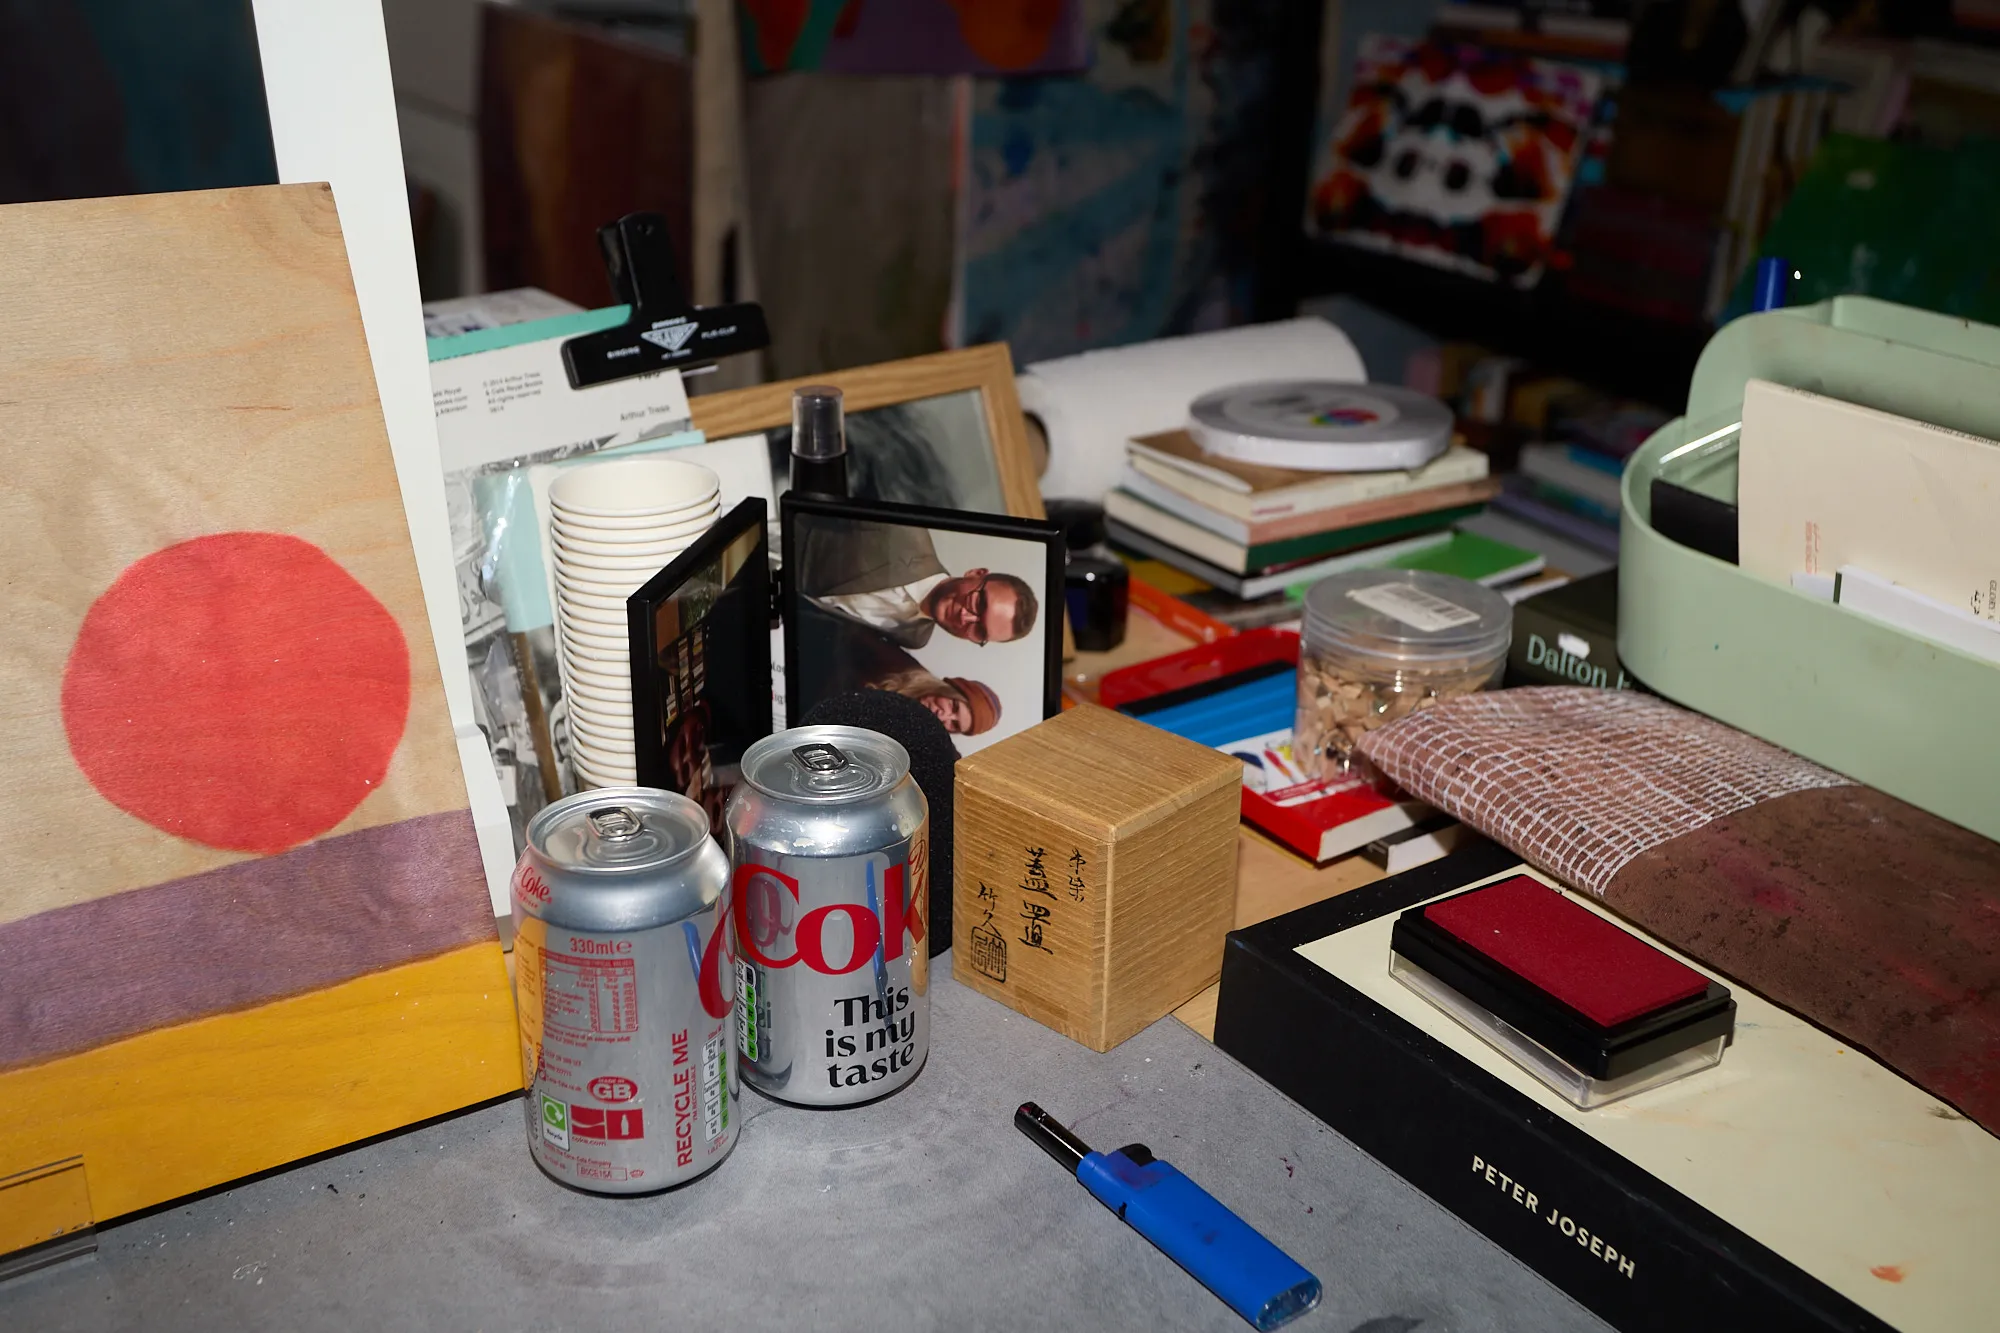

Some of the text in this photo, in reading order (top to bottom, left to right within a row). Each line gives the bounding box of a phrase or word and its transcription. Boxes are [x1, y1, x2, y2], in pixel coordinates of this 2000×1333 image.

[620, 404, 670, 422] Arthur Tress
[1527, 633, 1608, 690] Dalton
[834, 986, 909, 1026] This
[825, 1010, 915, 1058] is my
[827, 1042, 914, 1088] taste
[592, 1084, 632, 1100] GB
[672, 1028, 693, 1168] RECYCLE ME
[1472, 1155, 1636, 1279] PETER JOSEPH
